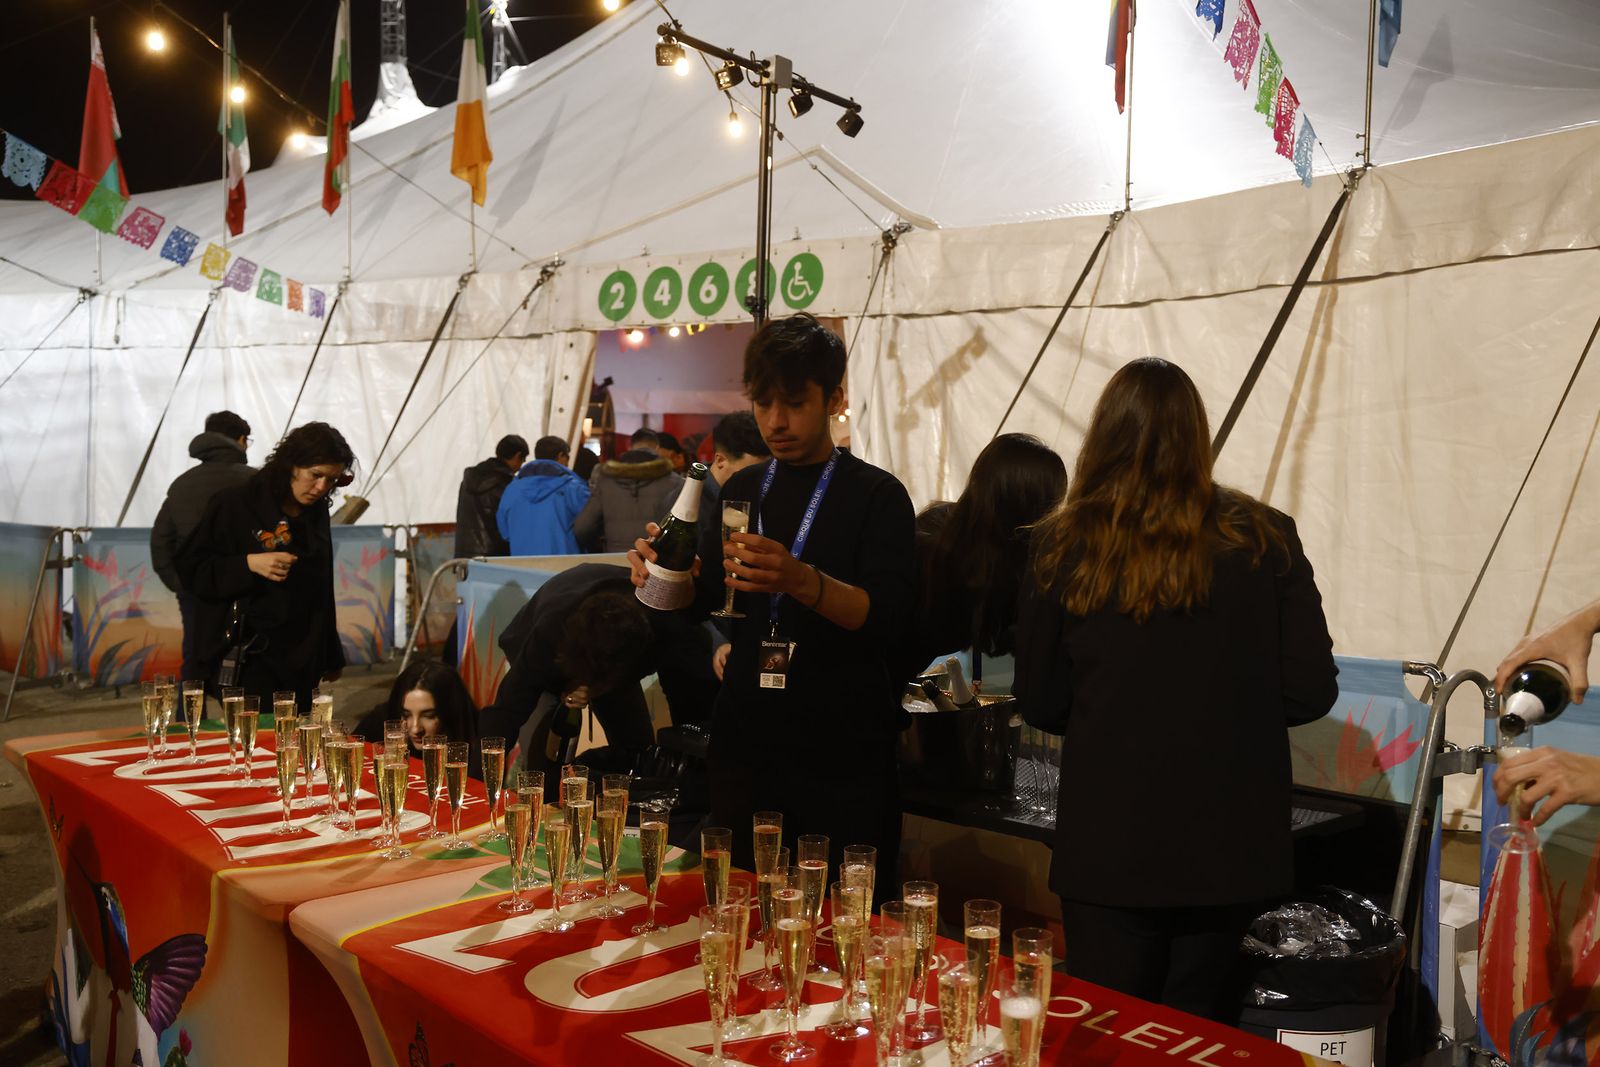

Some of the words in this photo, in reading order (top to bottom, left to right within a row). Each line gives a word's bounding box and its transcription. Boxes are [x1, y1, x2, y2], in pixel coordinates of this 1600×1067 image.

[610, 281, 626, 310] 2
[653, 278, 672, 306] 4
[700, 275, 718, 304] 6
[797, 519, 811, 543] CIRQUE
[806, 508, 814, 519] DU
[810, 488, 823, 508] SOLEIL
[1320, 1041, 1347, 1056] PET
